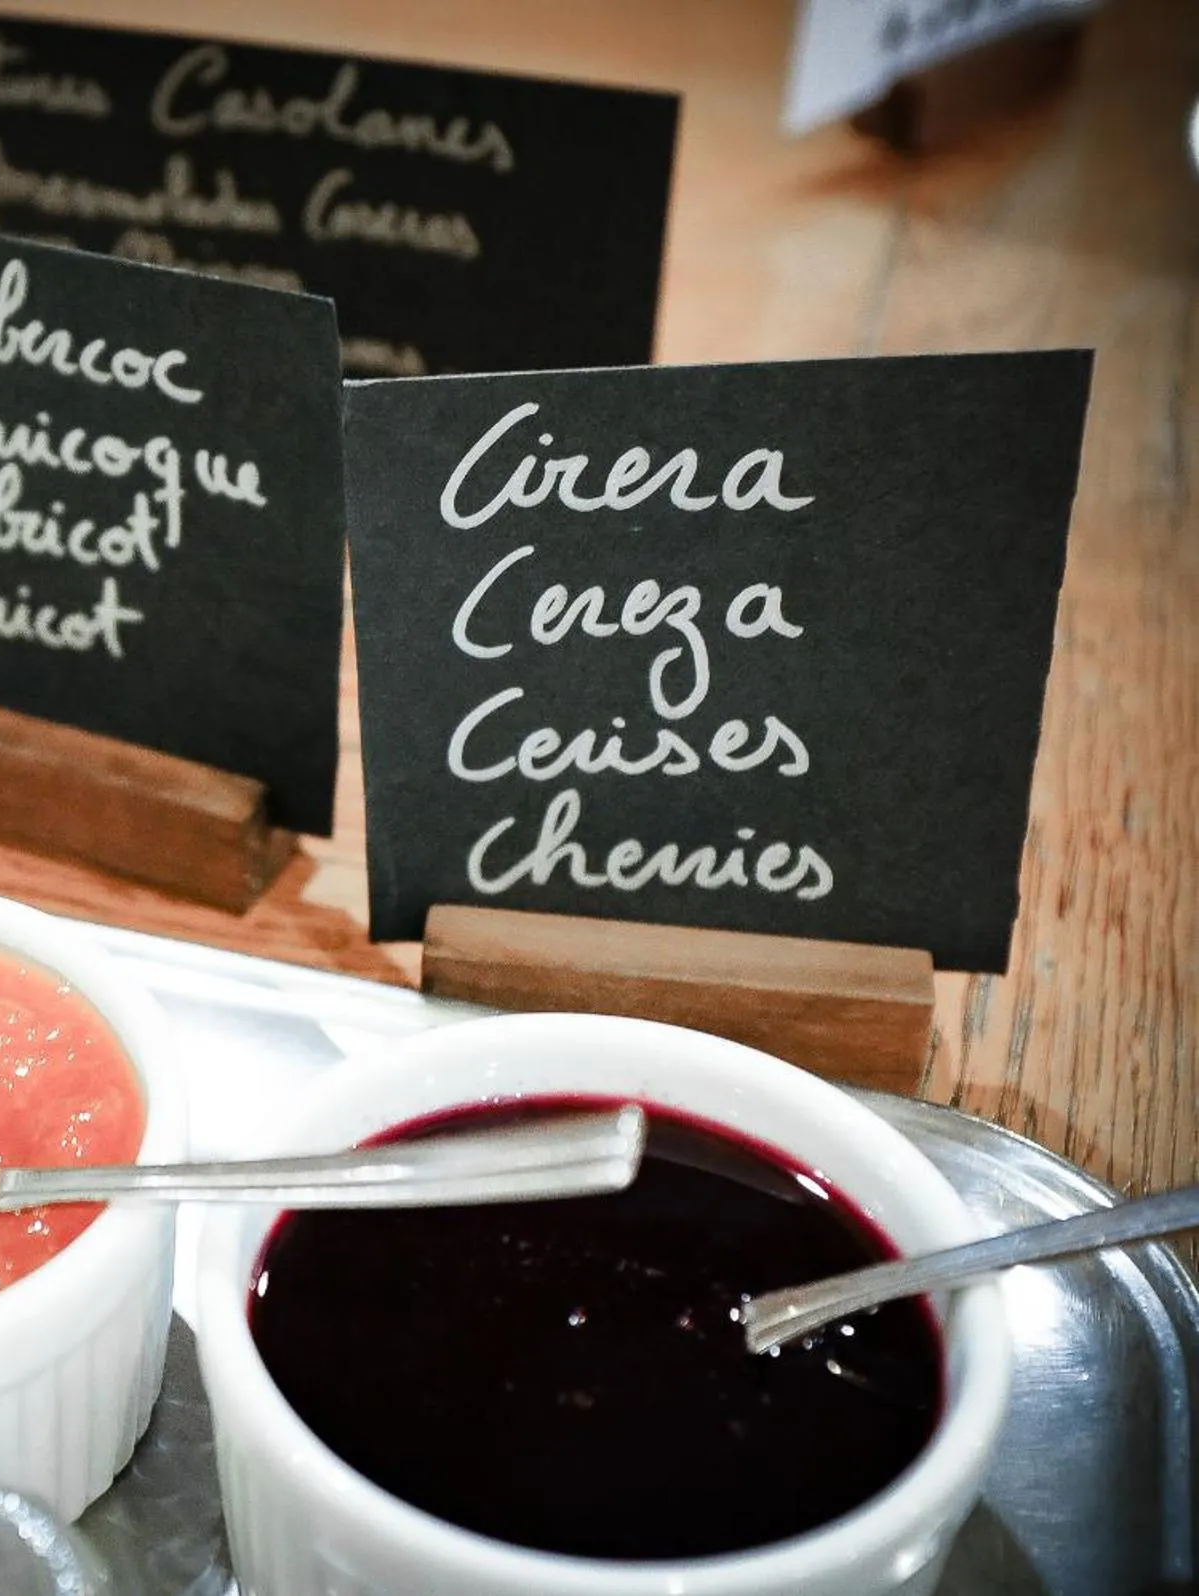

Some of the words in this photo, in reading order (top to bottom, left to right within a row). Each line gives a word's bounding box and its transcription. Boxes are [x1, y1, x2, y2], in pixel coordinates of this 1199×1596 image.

[440, 402, 816, 530] Cirera
[452, 545, 804, 719] Cereza
[447, 687, 810, 781] Cerises
